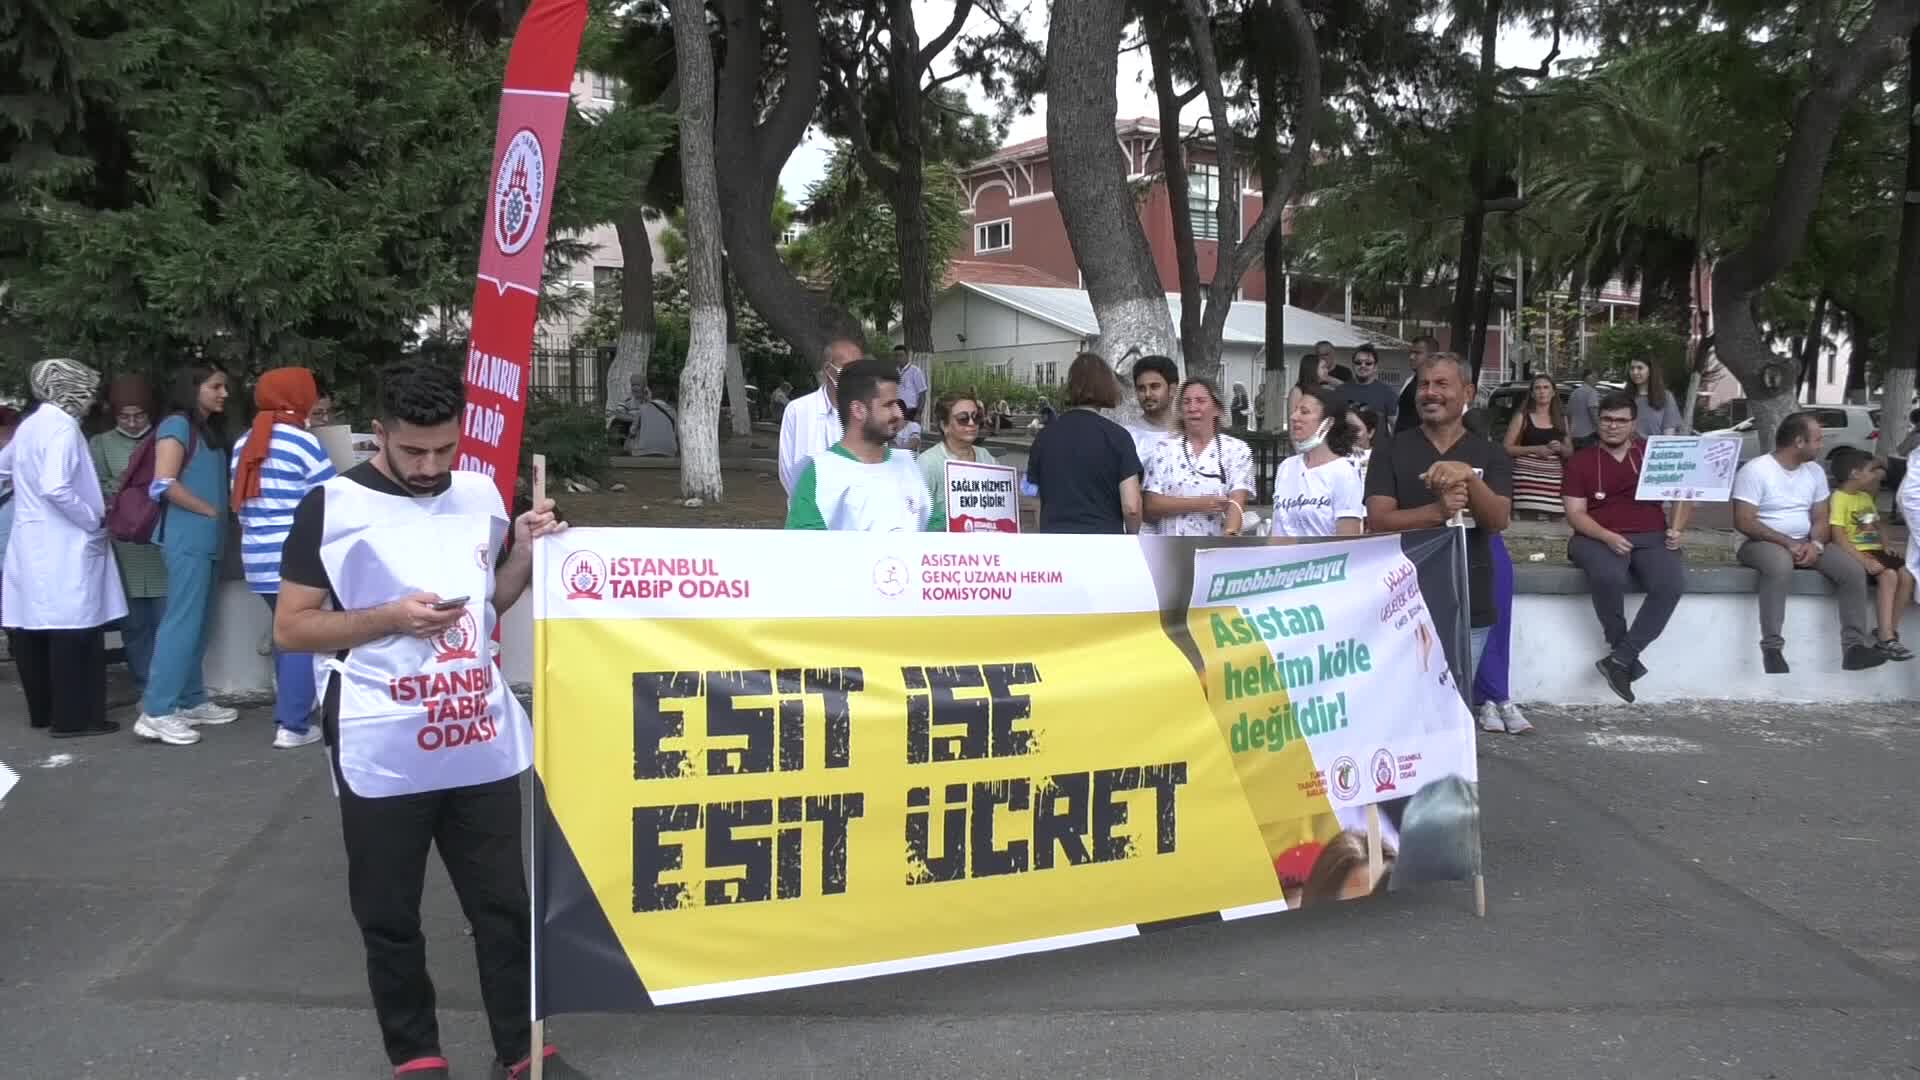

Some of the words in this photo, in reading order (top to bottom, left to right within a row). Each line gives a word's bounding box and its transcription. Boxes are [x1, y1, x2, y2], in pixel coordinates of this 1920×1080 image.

[467, 340, 521, 402] İTANBUL
[464, 402, 505, 449] TABİP
[951, 478, 979, 492] SAĞLIK
[981, 478, 1012, 492] HİZMETİ
[960, 494, 979, 508] EKİP
[610, 557, 719, 577] İSTANBUL
[921, 554, 979, 567] ASİSTAN
[982, 554, 1001, 567] VE
[922, 570, 961, 586] GENÇ
[964, 571, 1017, 583] UZMAN
[609, 579, 673, 598] TABİP
[678, 579, 749, 599] ODASI
[922, 587, 1012, 600] KOMİSYONU
[1210, 604, 1325, 648] Asistan
[389, 664, 493, 701] İSTANBU
[1224, 652, 1314, 700] hekim
[1318, 638, 1372, 681] köle
[417, 715, 497, 750] ODASI
[632, 666, 865, 780] EŞİT
[900, 662, 1043, 765] İŞE
[1231, 691, 1349, 753] değildir!
[632, 792, 865, 913] EŞİT
[905, 761, 1188, 886] ÜCRET
